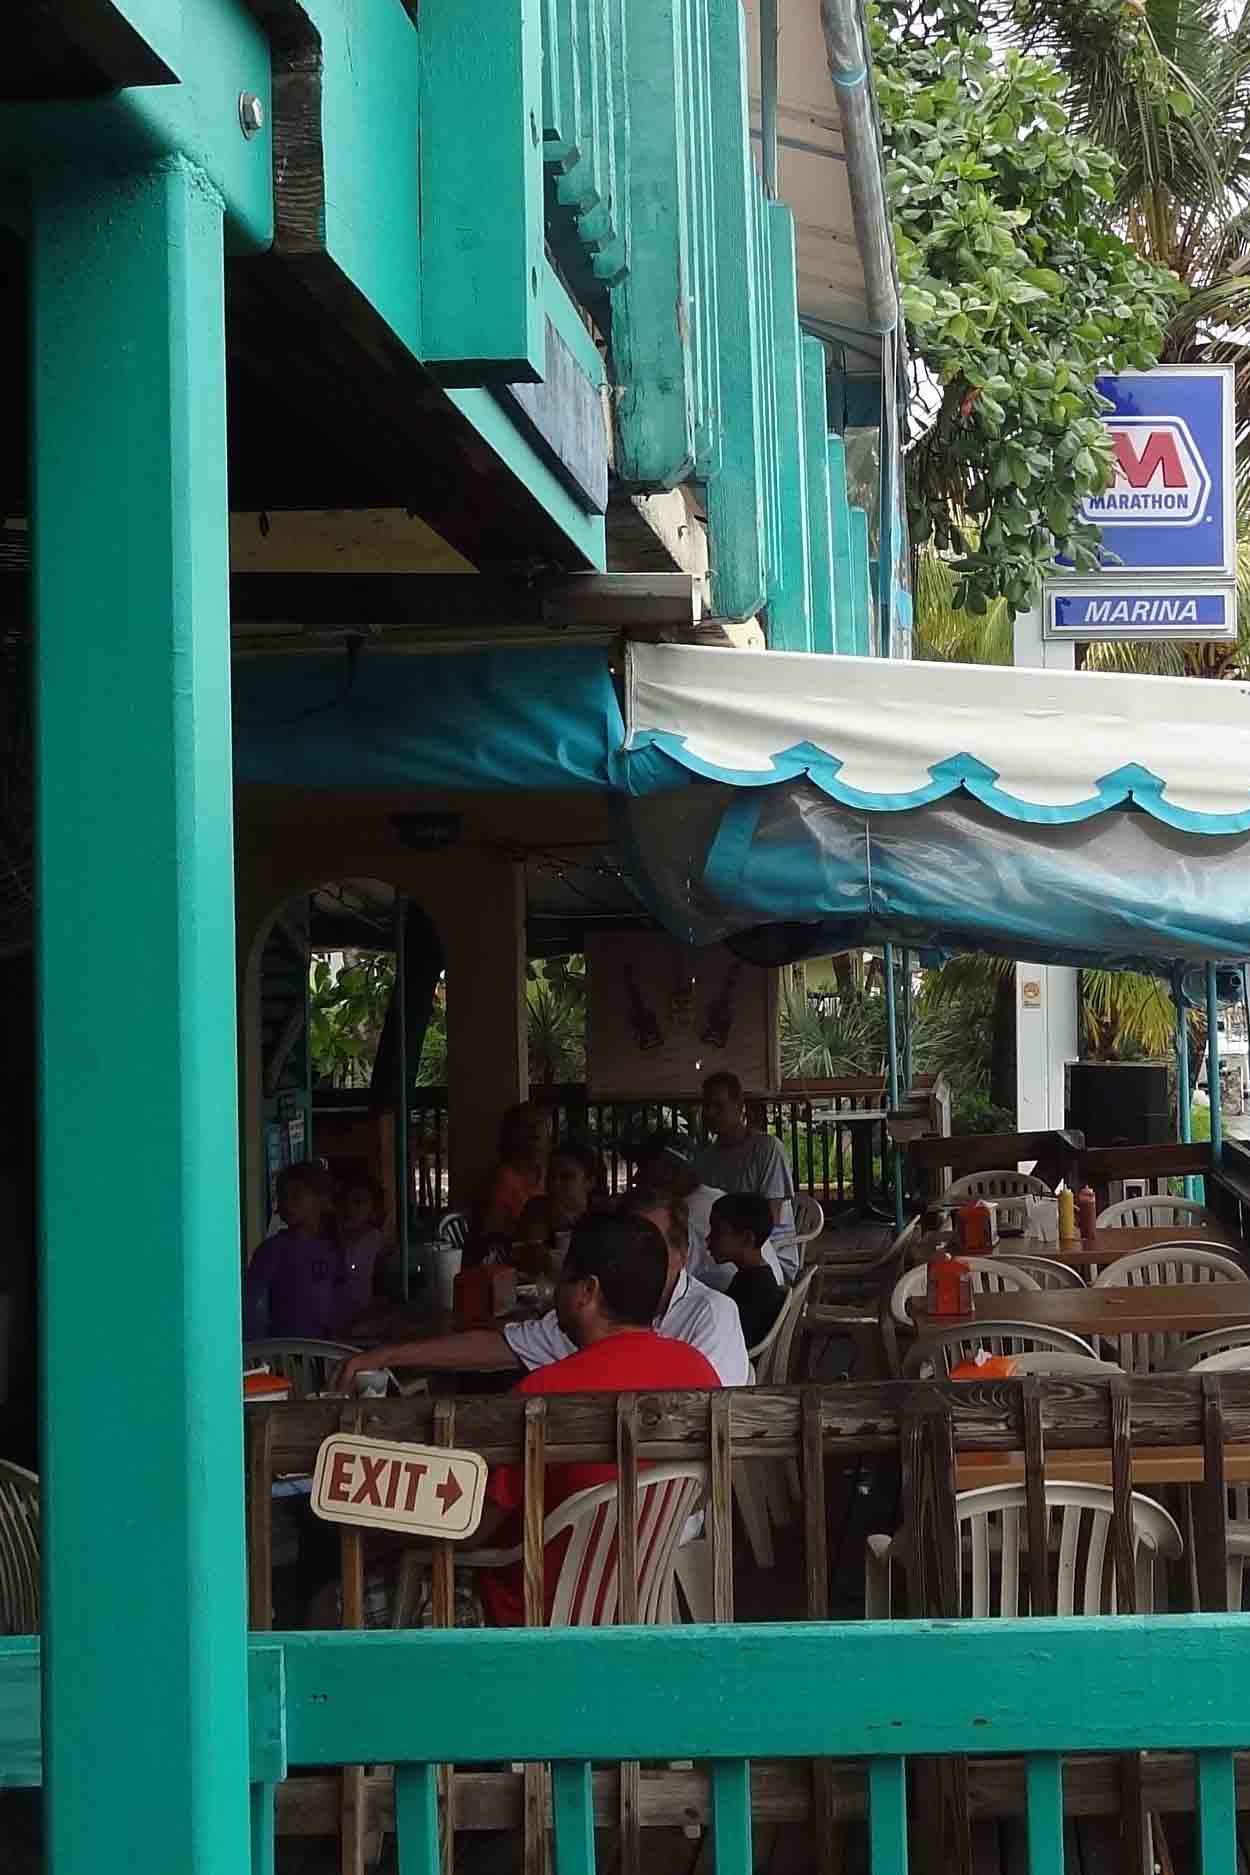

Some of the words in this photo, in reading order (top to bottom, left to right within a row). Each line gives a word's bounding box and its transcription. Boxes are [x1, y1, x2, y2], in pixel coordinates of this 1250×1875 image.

[1088, 494, 1188, 510] MARATHON
[1084, 600, 1198, 623] MARINA
[327, 1452, 429, 1512] EXIT
